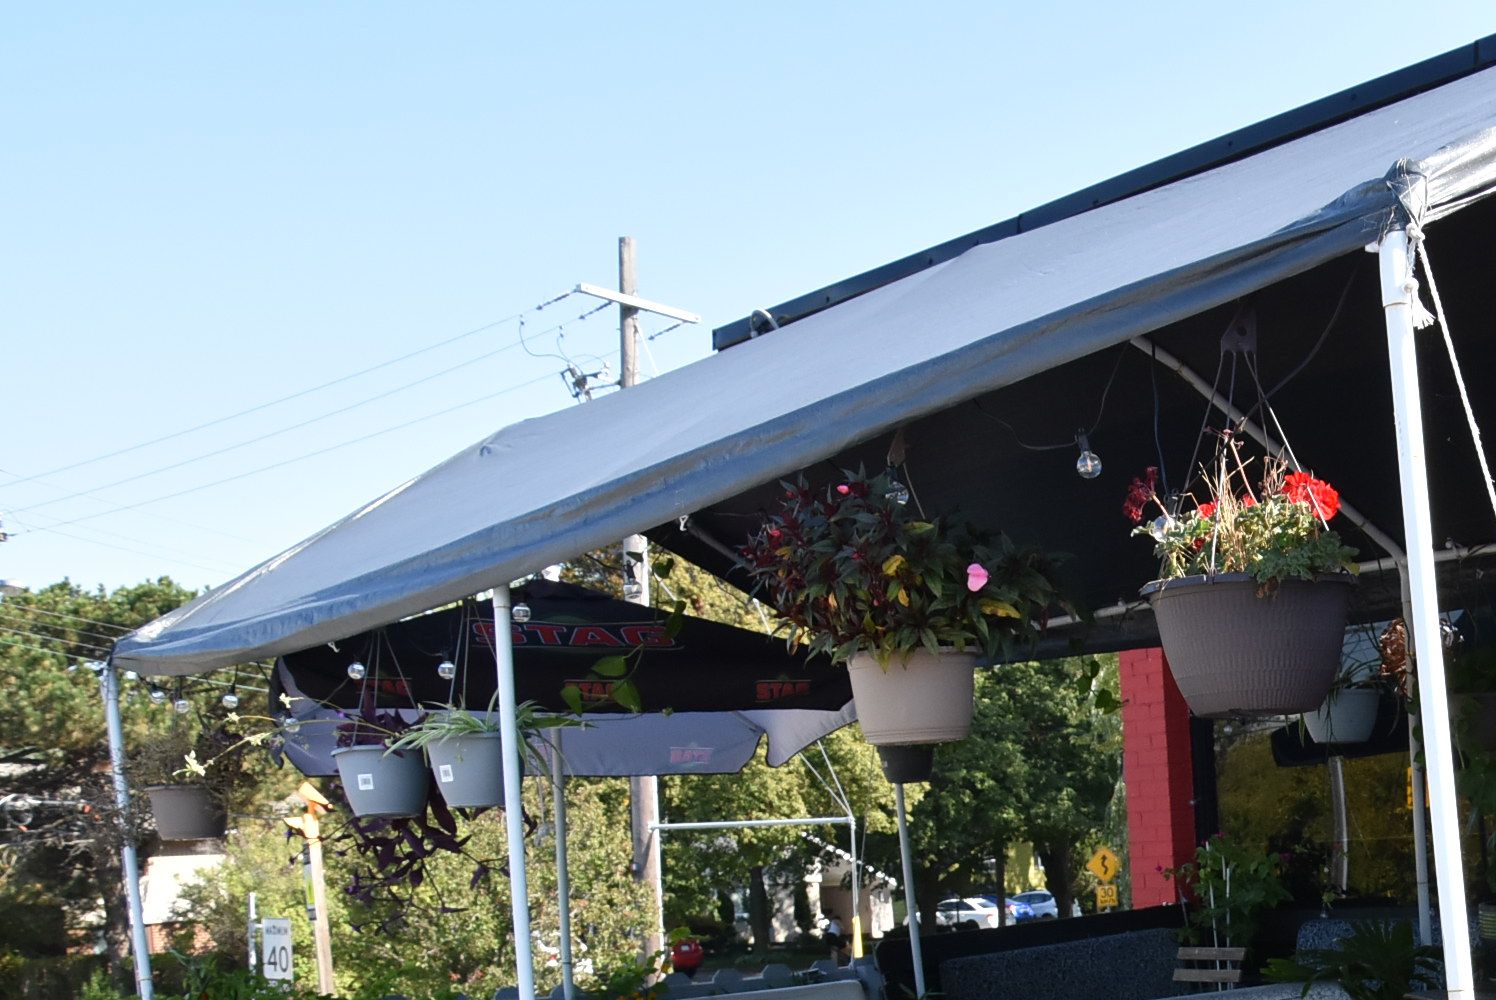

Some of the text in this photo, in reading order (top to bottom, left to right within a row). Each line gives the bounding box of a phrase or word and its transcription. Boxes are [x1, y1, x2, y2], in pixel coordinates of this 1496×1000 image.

[472, 622, 676, 648] STAG
[1100, 887, 1114, 898] 30
[267, 945, 289, 973] 40
